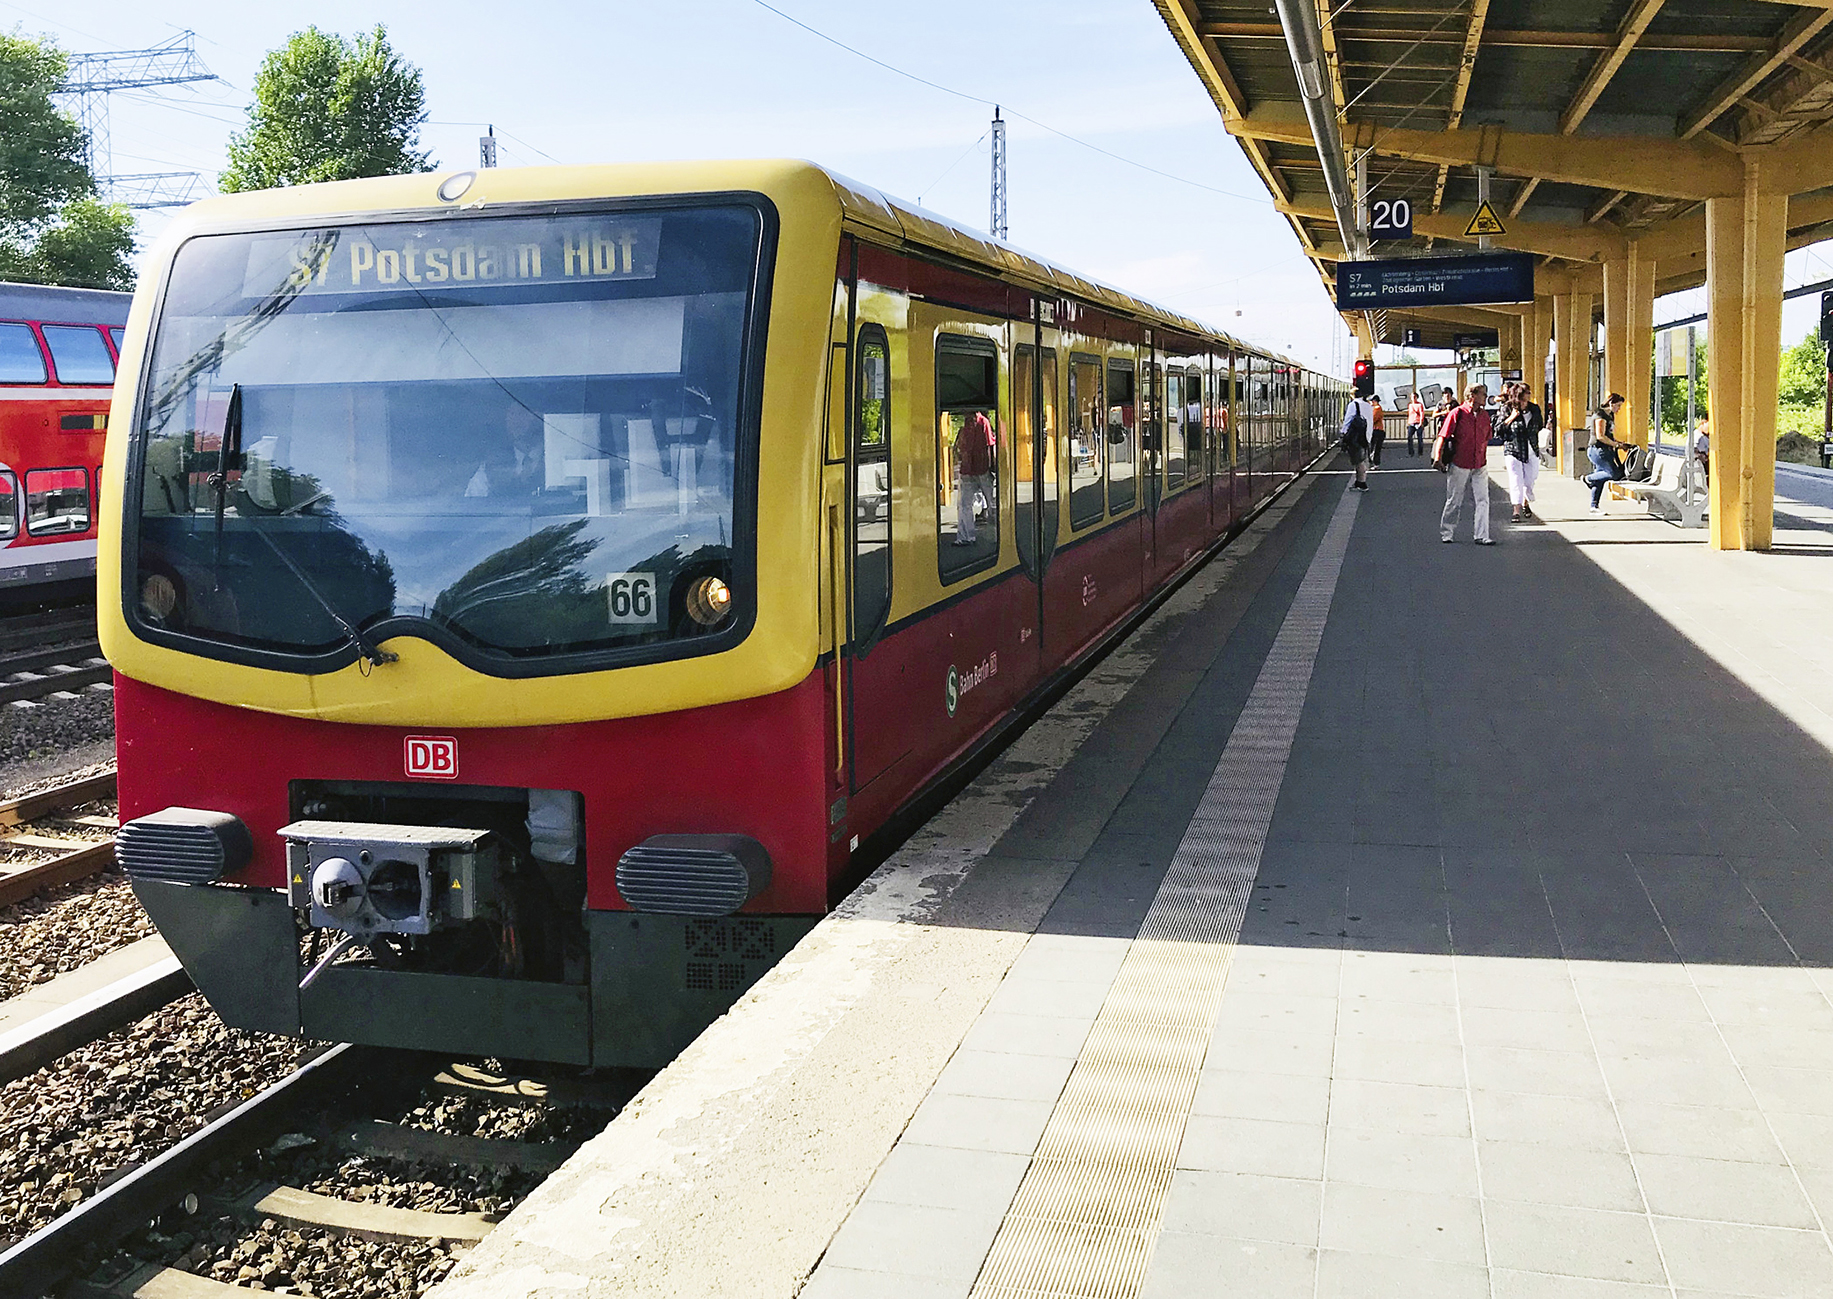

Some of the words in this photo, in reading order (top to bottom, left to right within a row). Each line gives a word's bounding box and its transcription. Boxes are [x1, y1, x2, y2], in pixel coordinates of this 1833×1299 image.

[1373, 199, 1410, 230] 20
[350, 239, 543, 286] Potsdam
[563, 228, 639, 277] Hbf
[1349, 273, 1362, 283] S7
[1381, 283, 1425, 294] Potsdam
[1428, 282, 1445, 292] Hbf
[611, 578, 652, 617] 66
[959, 671, 974, 696] Bahn
[974, 658, 990, 686] Berlin
[411, 742, 452, 771] DB
